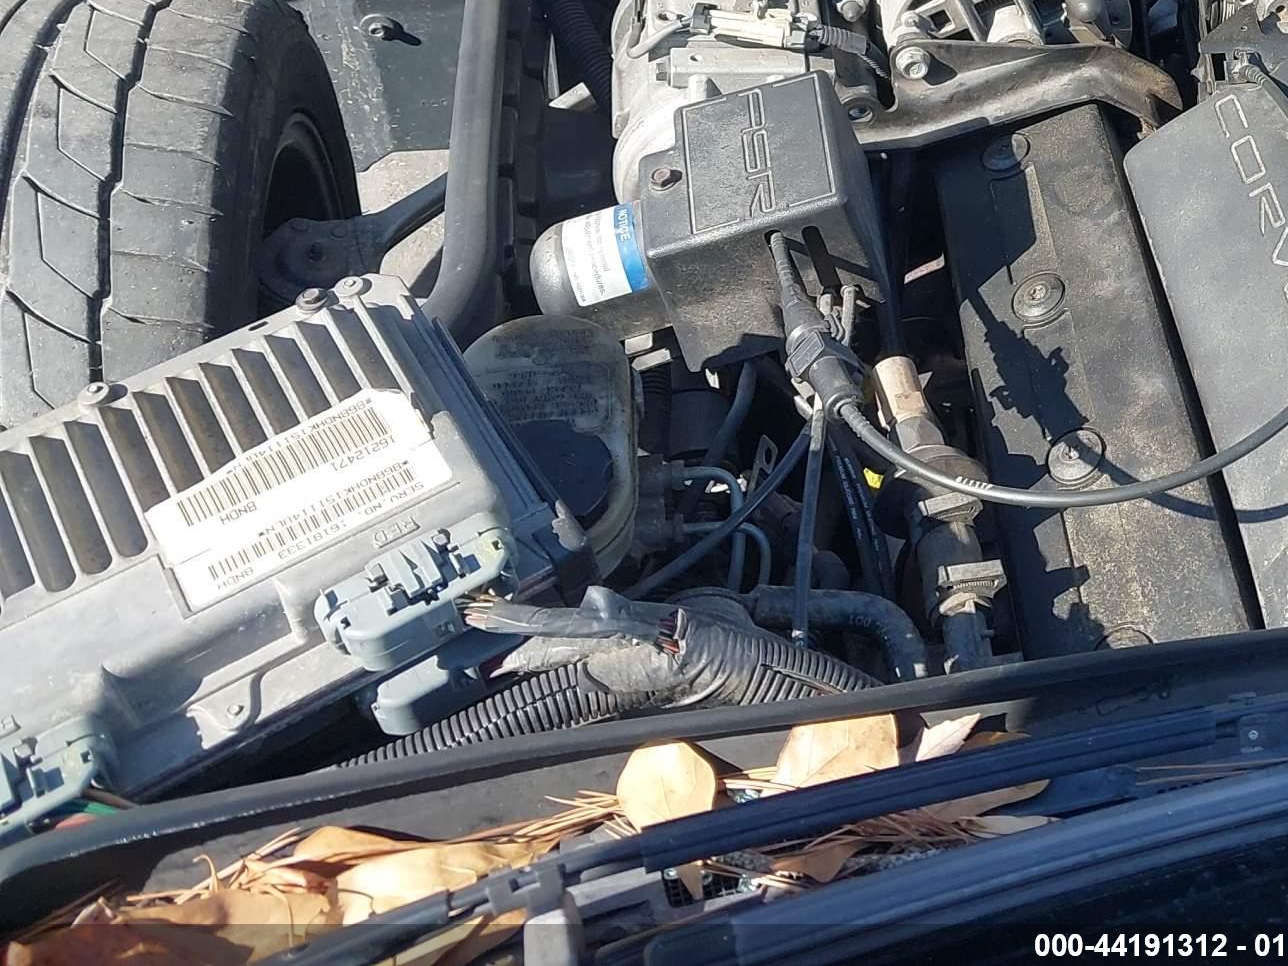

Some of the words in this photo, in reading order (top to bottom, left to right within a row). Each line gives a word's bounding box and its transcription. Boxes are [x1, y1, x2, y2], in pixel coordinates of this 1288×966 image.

[735, 88, 777, 219] ASR
[618, 208, 632, 242] NOTICE
[330, 434, 397, 473] 16212471
[372, 515, 417, 545] RED
